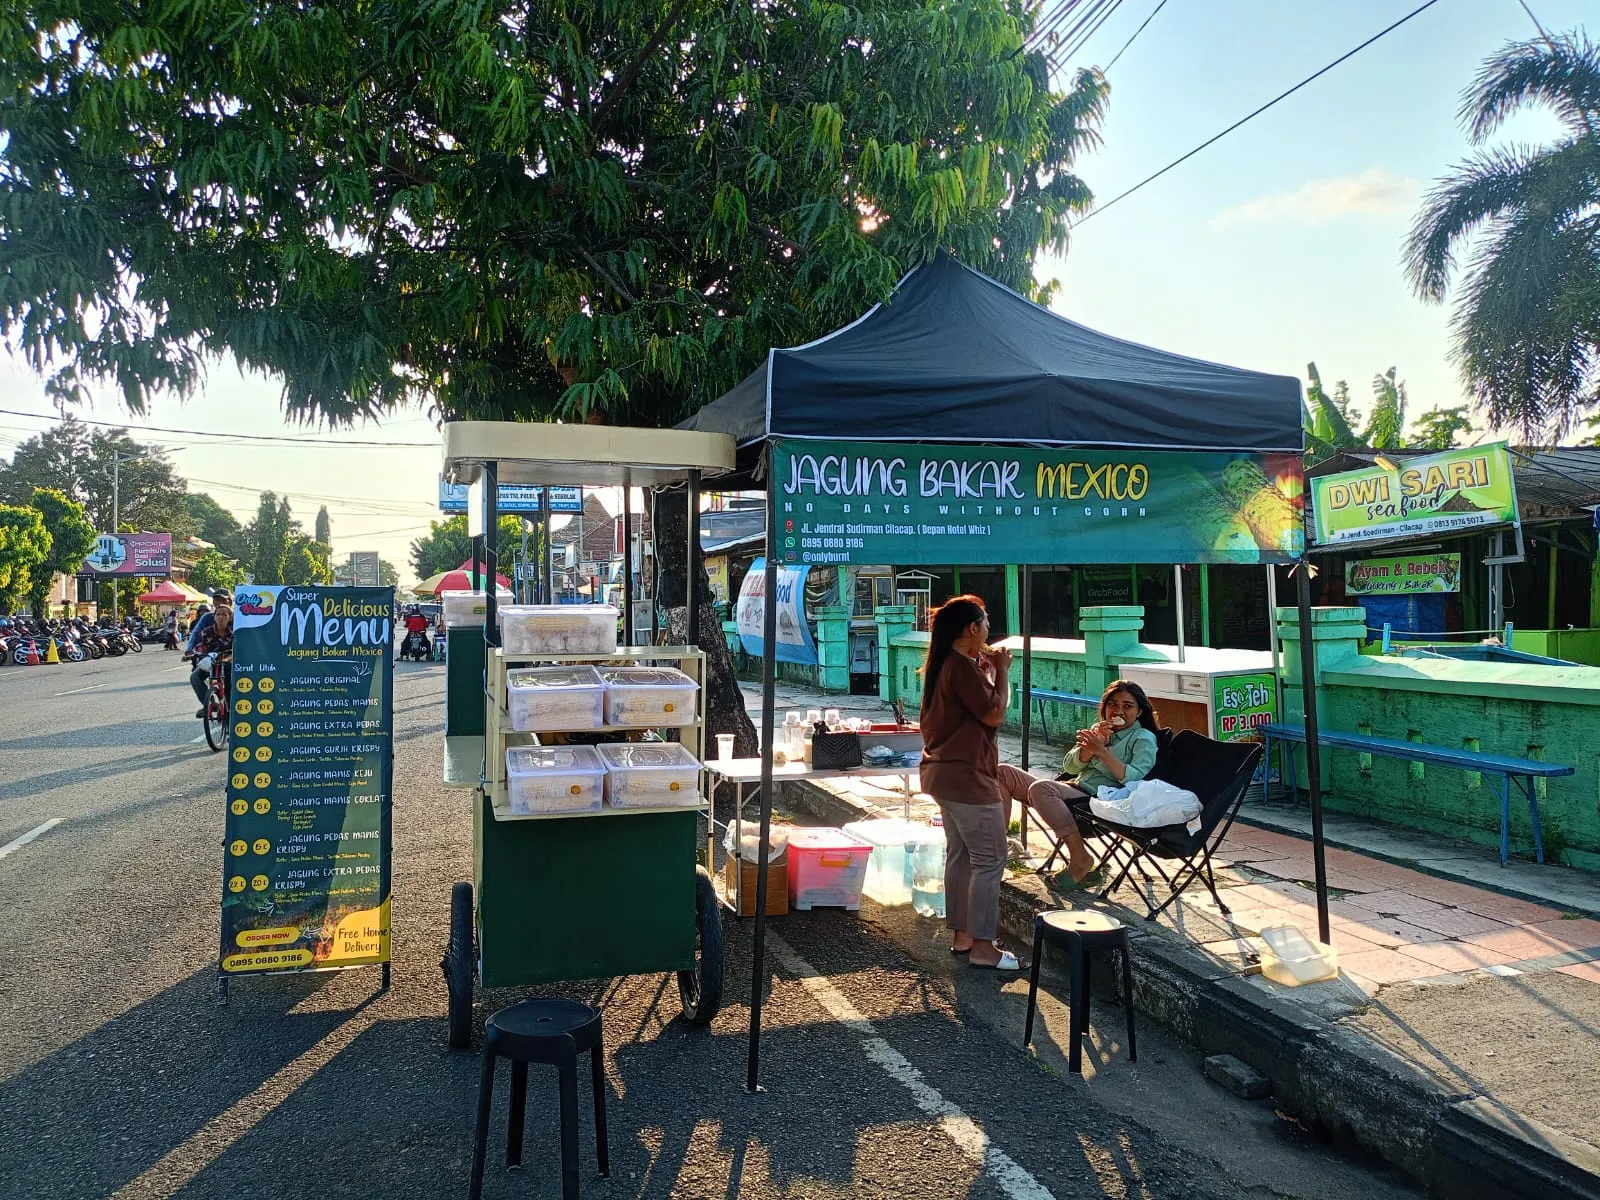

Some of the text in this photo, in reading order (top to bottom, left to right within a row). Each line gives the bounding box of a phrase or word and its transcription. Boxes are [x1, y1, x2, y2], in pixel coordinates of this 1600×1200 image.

[783, 454, 1149, 500] JAGUNG BAKAR MEXICO
[1329, 457, 1490, 510] DWI SARI
[1367, 482, 1445, 520] seafood
[784, 503, 1146, 517] NO DAYS WITHOUT CORN
[814, 523, 844, 534] Jendral
[846, 523, 884, 534] Sudirman
[885, 524, 915, 536] Cilacap.
[948, 525, 967, 534] Hotel
[1434, 520, 1450, 528] 0813
[1363, 528, 1395, 537] Soedirman
[1400, 524, 1423, 533] Cilacap
[801, 538, 863, 548] 0895 0880 9186
[135, 558, 166, 567] Solusi
[803, 552, 850, 563] @onlyburnt
[1357, 560, 1447, 579] Ayam & Bebek
[286, 588, 319, 604] Super
[324, 598, 389, 617] Delicious
[281, 602, 389, 646] Menu
[287, 646, 382, 659] Jagung Bakar Mexico
[290, 676, 360, 685] JAGUNG ORIGINAL
[1223, 681, 1269, 709] Es Teh
[325, 699, 348, 707] PEDAS
[353, 698, 379, 706] MANIS
[290, 722, 320, 730] JAGUNG
[325, 721, 352, 729] EXTRA
[1222, 712, 1272, 733] RP 3.000
[290, 746, 320, 755] JAGUNG
[289, 769, 372, 780] JAGUNG MANIS KEJU
[289, 795, 386, 806] JAGUNG MANIS COKLAT
[289, 831, 379, 843] JAGUNG PEDAS MANIS
[277, 845, 306, 854] KRISPY
[288, 866, 381, 878] JAGUNG EXTRA PEDAS
[275, 881, 305, 889] KRISPY
[339, 926, 388, 939] Free Home
[345, 941, 381, 953] Delivery
[230, 954, 302, 967] 0895 0880 9186
